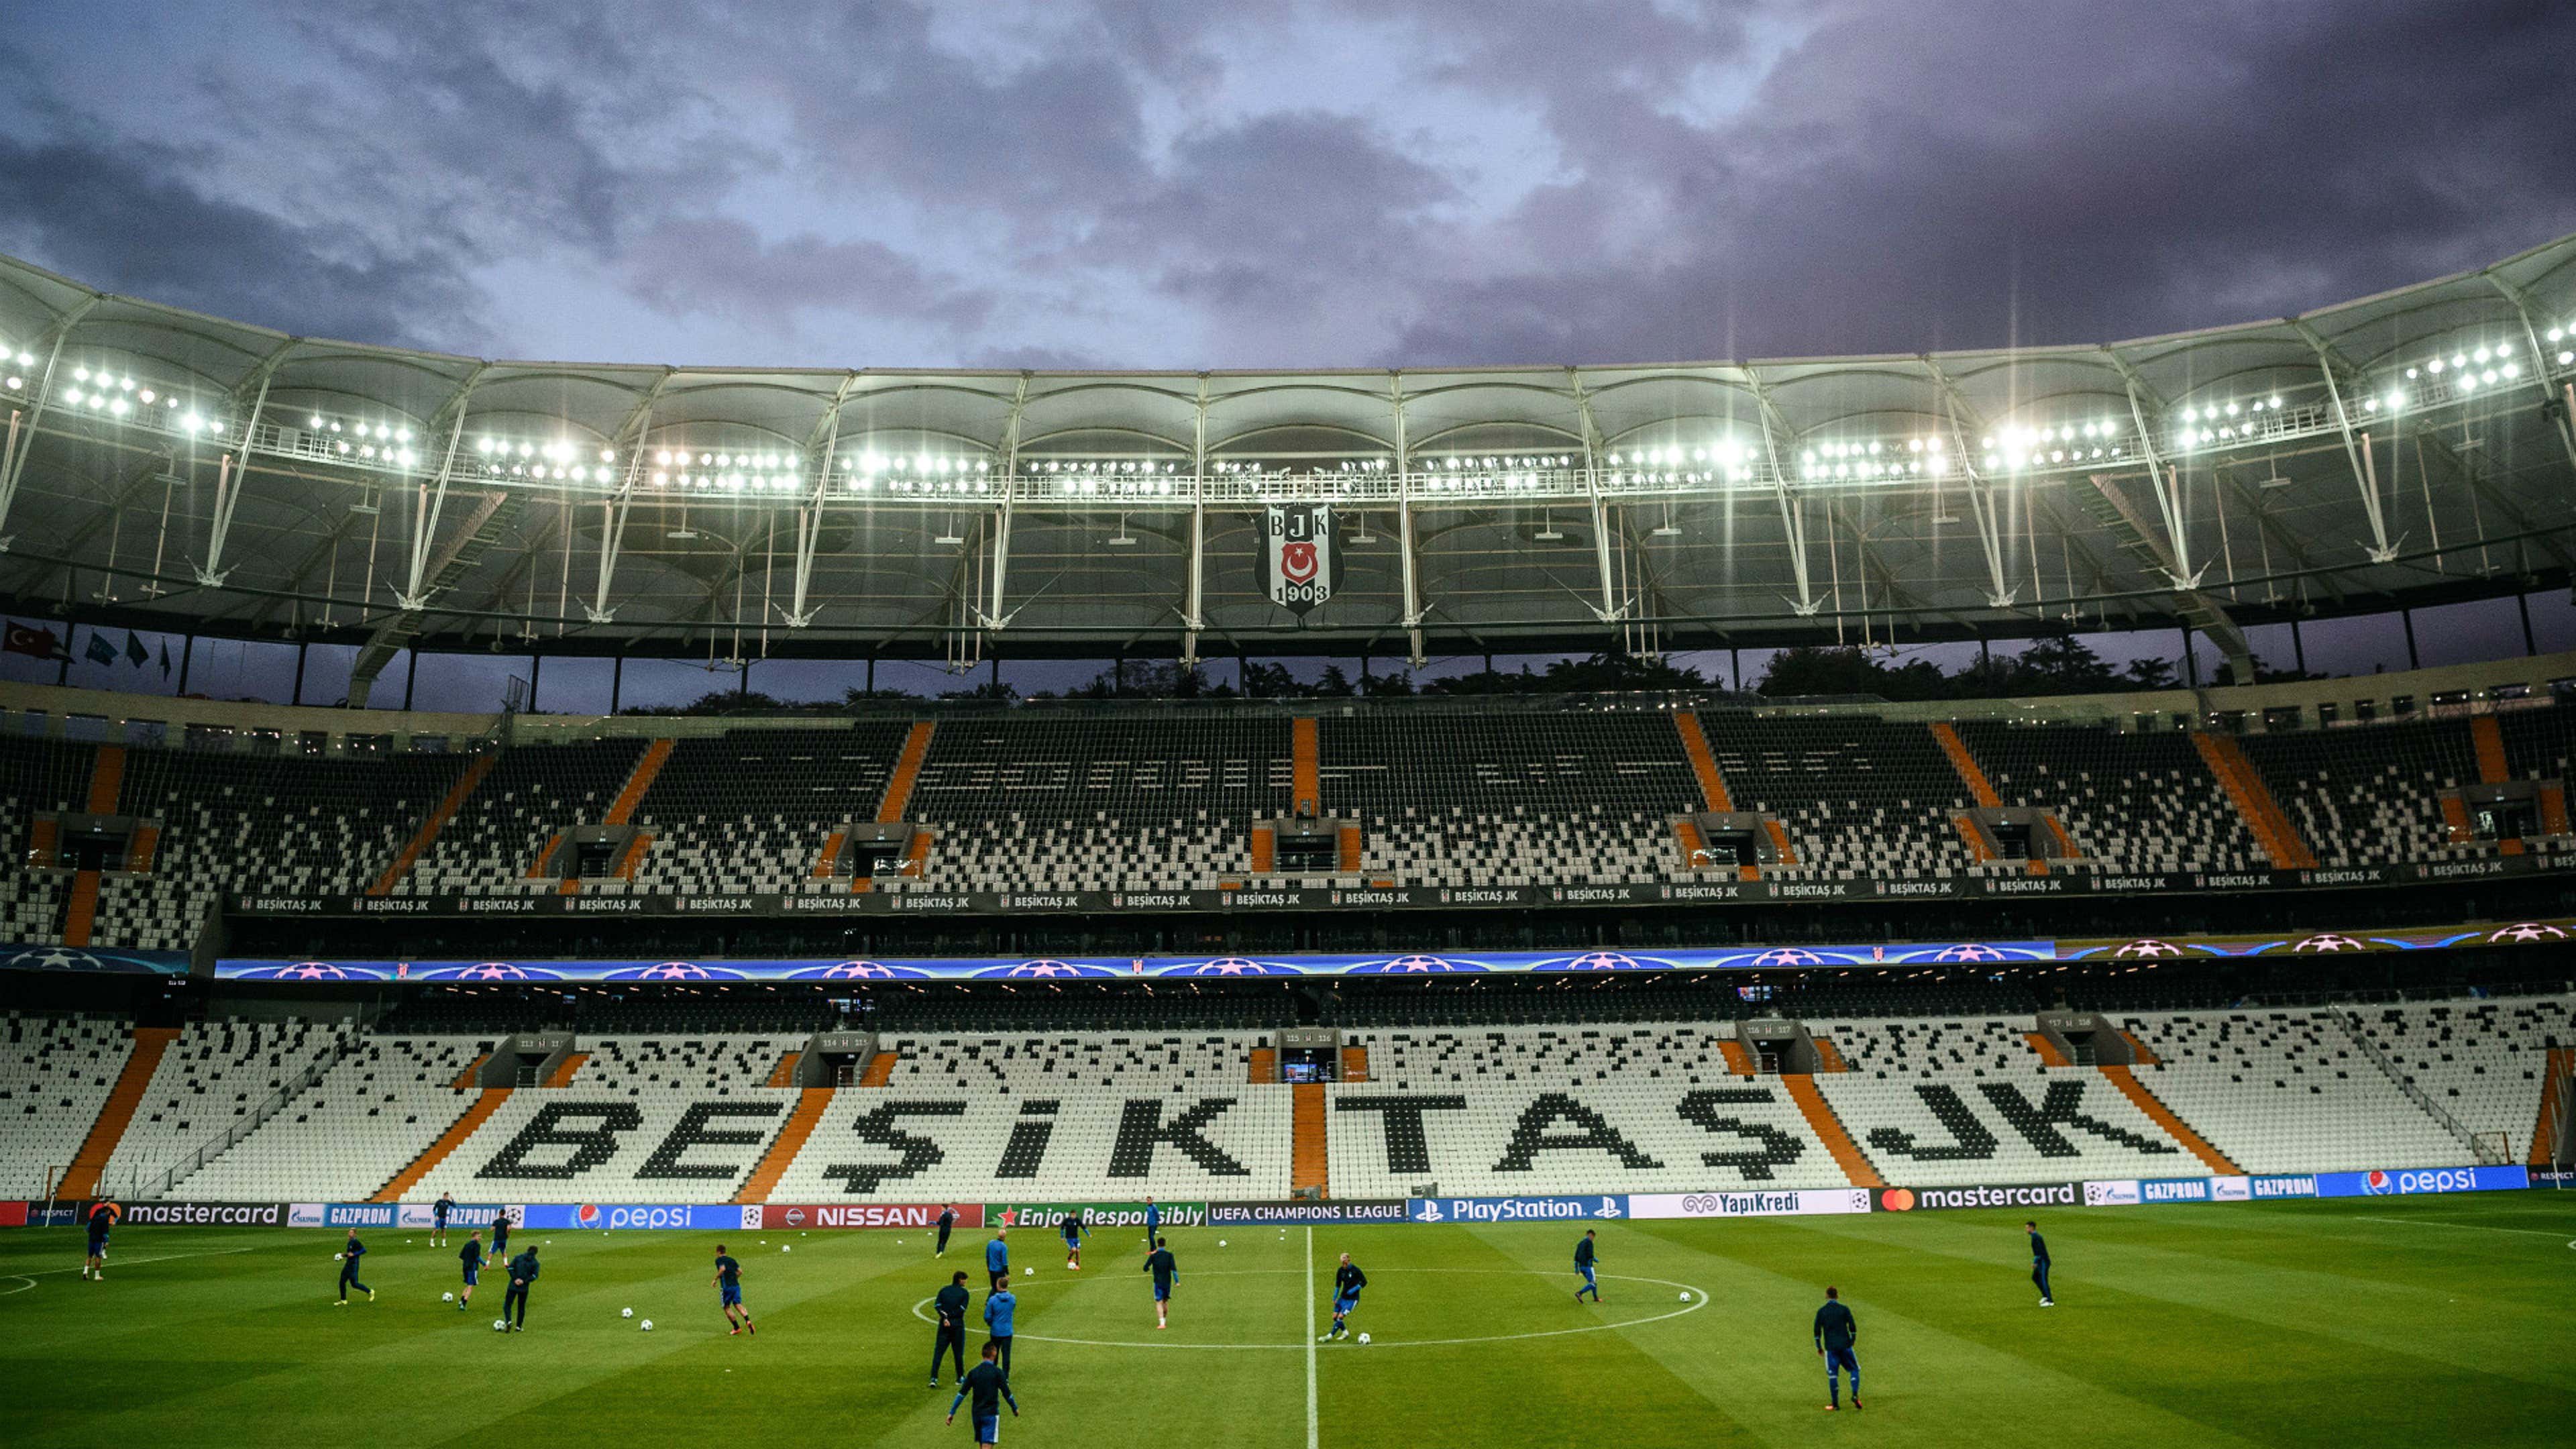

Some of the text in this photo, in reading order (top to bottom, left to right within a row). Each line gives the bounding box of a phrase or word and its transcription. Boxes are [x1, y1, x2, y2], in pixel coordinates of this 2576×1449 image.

[1271, 515, 1327, 537] BJK
[1277, 586, 1327, 601] 1903
[2485, 863, 2503, 872] JK
[2257, 875, 2269, 884] JK
[2367, 871, 2380, 880] JK
[1939, 883, 1951, 892] JK
[2049, 880, 2061, 890] JK
[2153, 878, 2165, 888] JK
[1618, 890, 1629, 898] JK
[1726, 887, 1737, 896] JK
[1833, 885, 1845, 895] JK
[1177, 896, 1190, 905] JK
[1287, 894, 1299, 904] JK
[1397, 893, 1409, 902] JK
[1505, 891, 1517, 900] JK
[309, 900, 321, 910] JK
[416, 901, 428, 910] JK
[522, 900, 534, 910] JK
[629, 900, 641, 910] JK
[740, 900, 751, 908] JK
[848, 899, 860, 908] JK
[957, 898, 969, 907] JK
[1065, 896, 1077, 906] JK
[2400, 1167, 2477, 1194] pepsi
[2145, 1181, 2205, 1199] GAZPROM
[2254, 1178, 2314, 1195] GAZPROM
[1921, 1183, 2075, 1208] mastercard
[128, 1203, 278, 1224] mastercard
[331, 1208, 391, 1224] GAZPROM
[1212, 1205, 1401, 1221] UEFA CHAMPIONS LEAGUE
[1453, 1200, 1582, 1222] PlayStation
[610, 1205, 691, 1228] pepsi
[817, 1208, 928, 1226] NISSAN
